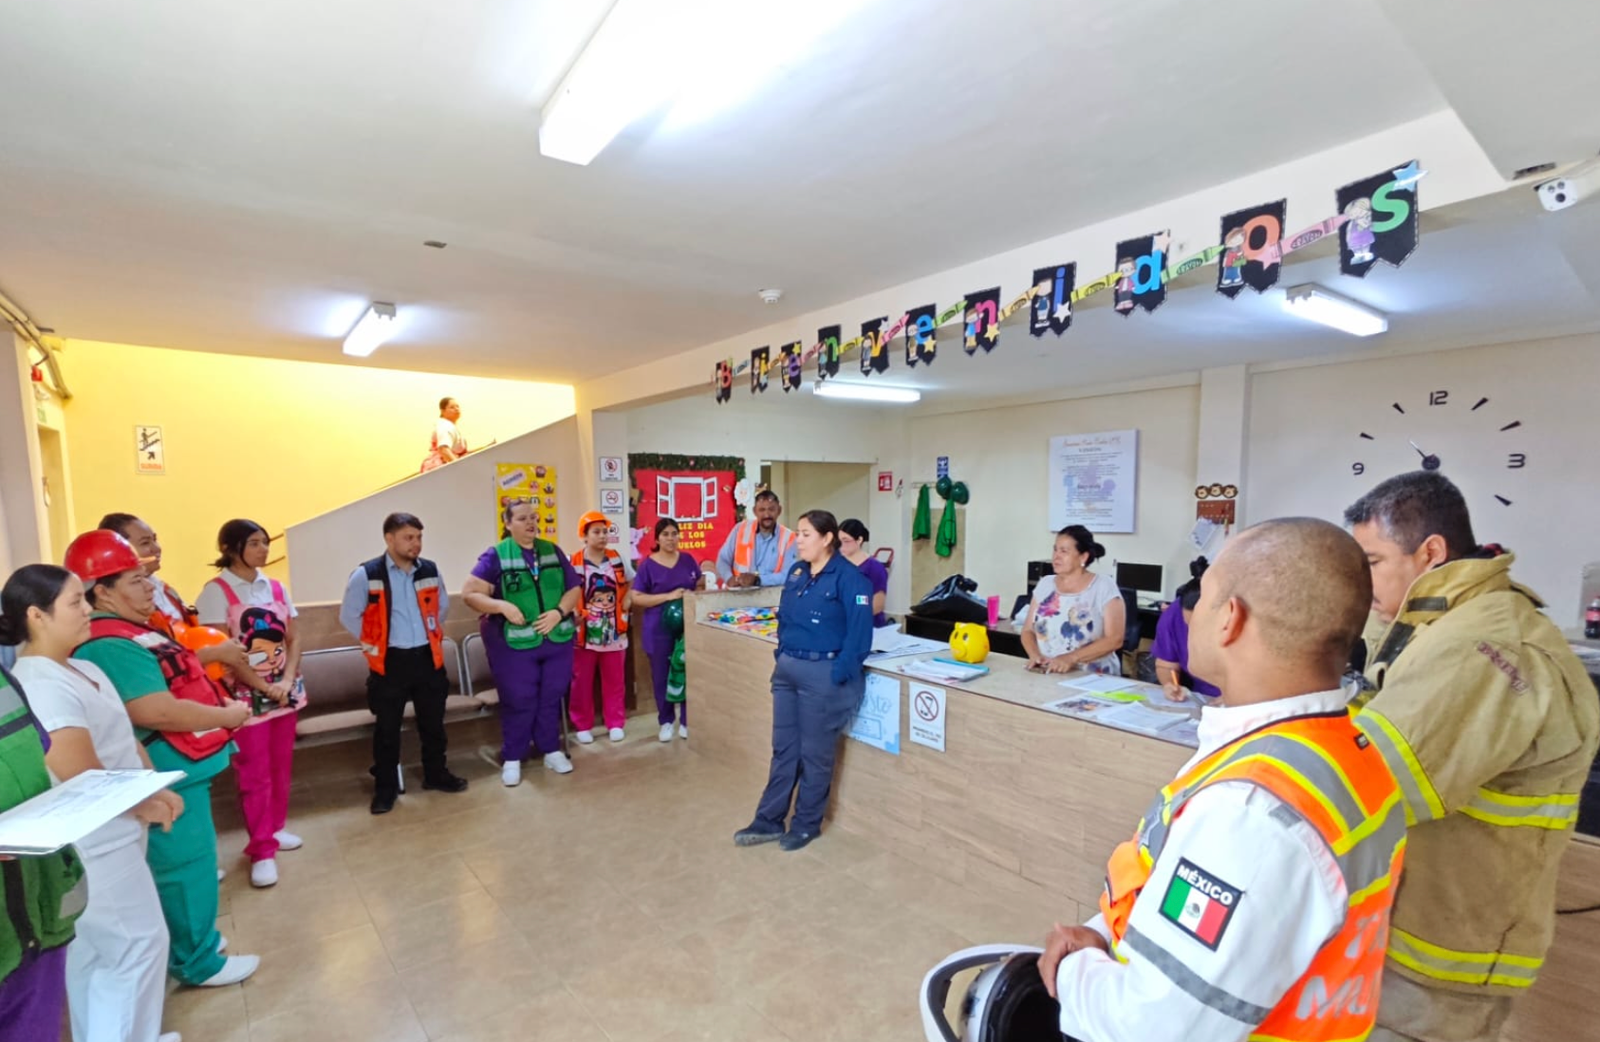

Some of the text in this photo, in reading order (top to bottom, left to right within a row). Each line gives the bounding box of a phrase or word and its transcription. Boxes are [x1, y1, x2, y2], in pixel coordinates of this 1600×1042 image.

[1429, 390, 1449, 406] 12
[1507, 453, 1526, 469] 3
[1352, 462, 1365, 476] 9
[678, 522, 693, 530] LIZ
[688, 531, 705, 539] LOS
[678, 541, 706, 549] UELOS
[1176, 864, 1233, 906] MÉXICO
